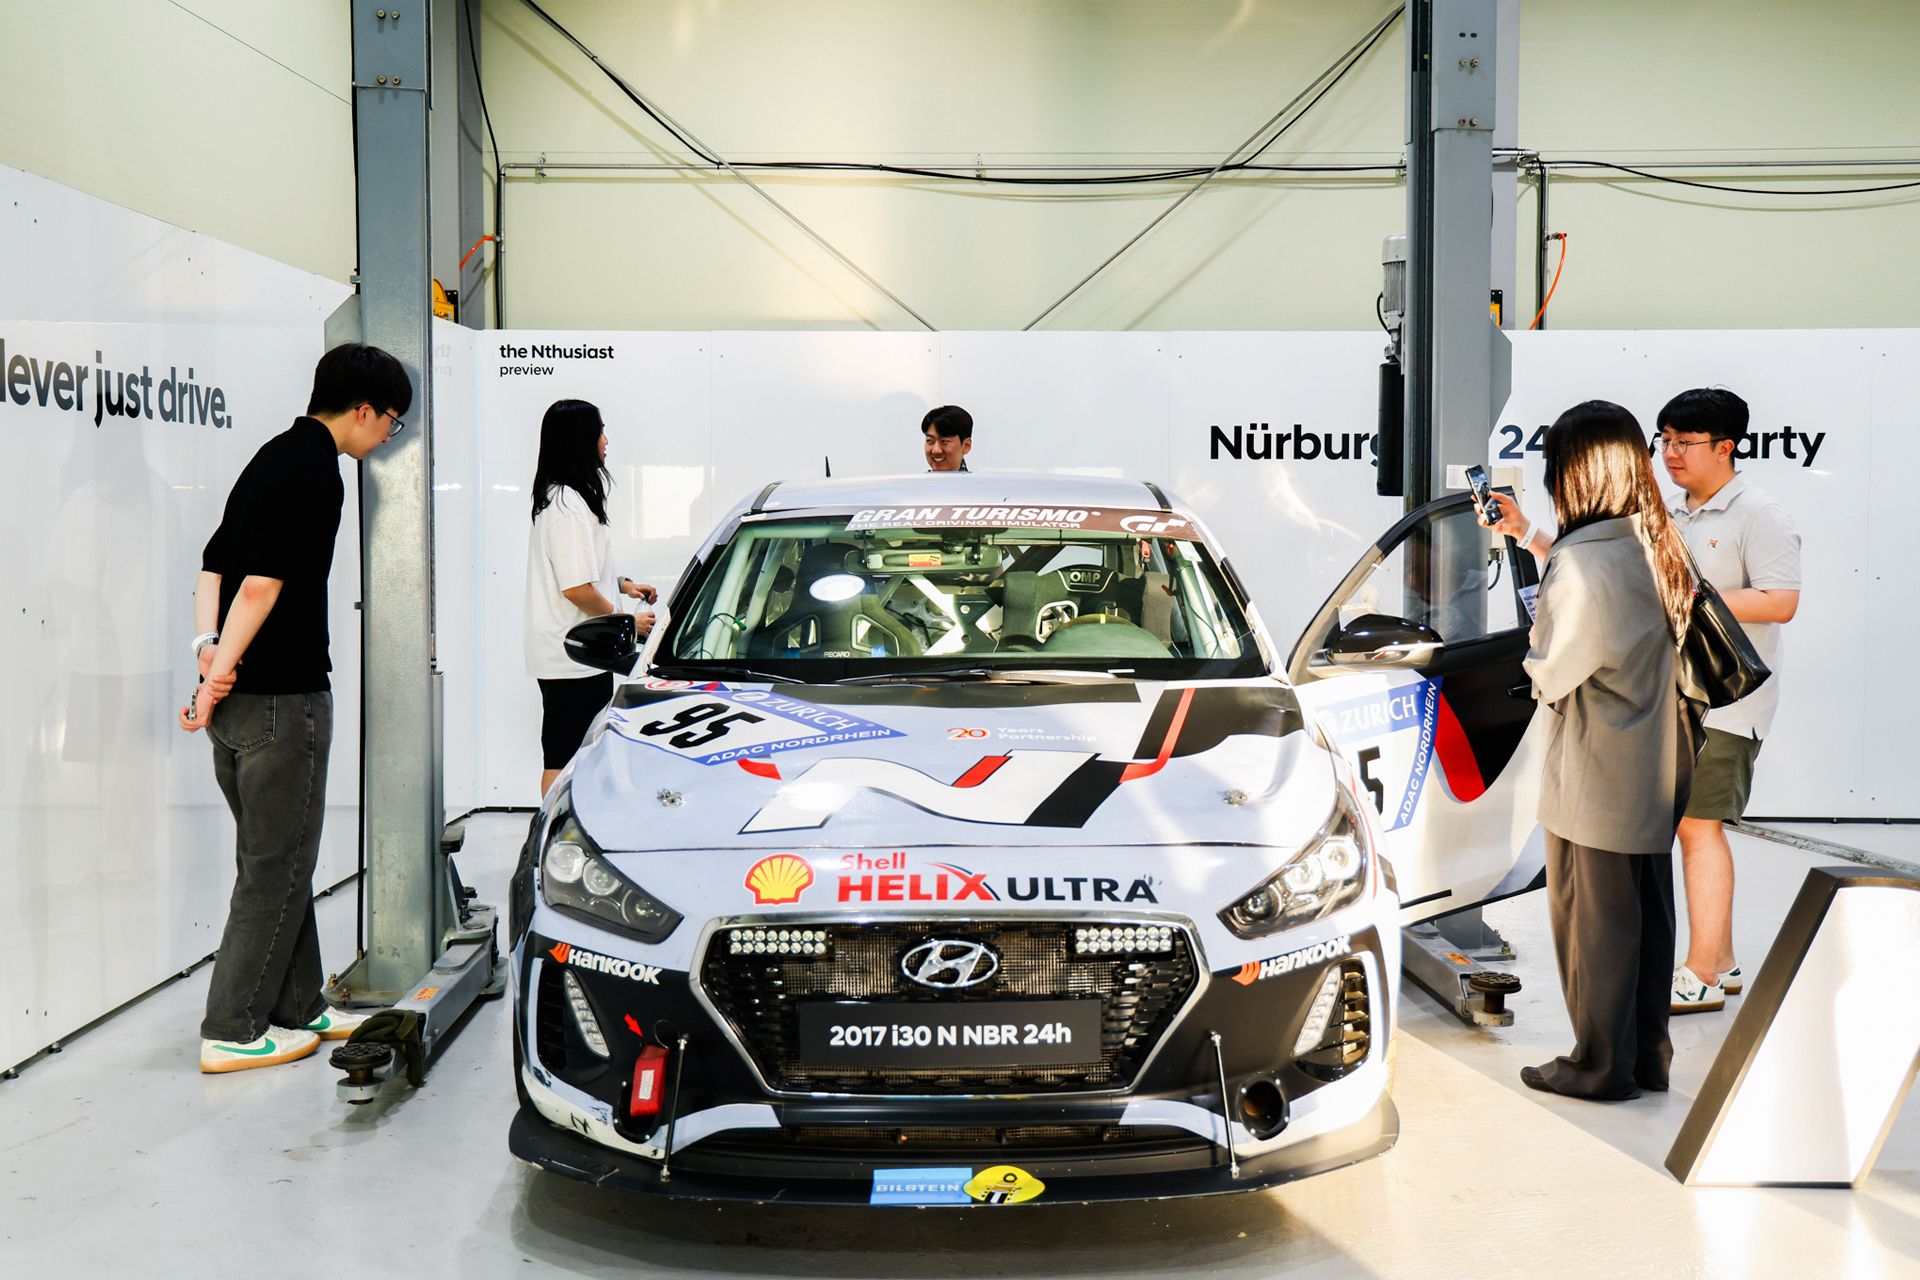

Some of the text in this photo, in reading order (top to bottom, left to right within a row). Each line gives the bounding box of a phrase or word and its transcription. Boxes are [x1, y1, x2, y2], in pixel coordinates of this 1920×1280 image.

[499, 344, 615, 359] the Nthusiast
[500, 363, 554, 377] preview
[0, 338, 232, 429] ever just drive.
[1499, 424, 1550, 459] 24
[1735, 425, 1826, 467] arty
[849, 521, 878, 529] THE
[991, 520, 1081, 529] SIMULATOR
[853, 507, 1089, 523] GRAN TURISMO
[1070, 570, 1101, 583] OMP
[639, 702, 766, 749] 95
[757, 698, 860, 731] ZURICH
[1339, 693, 1418, 735] ZURICH
[706, 728, 891, 763] ADAC NORDRHEIN
[947, 727, 991, 740] 20
[998, 733, 1099, 743] Partnership
[1399, 681, 1438, 825] ADAC NORDRHEIN
[1357, 745, 1384, 817] 5
[839, 852, 906, 871] Shell
[837, 872, 1159, 904] HELIX ULTRA
[829, 1022, 1072, 1046] 2017 i30 N NBR 24h
[875, 1184, 960, 1192] BILSTEIN
